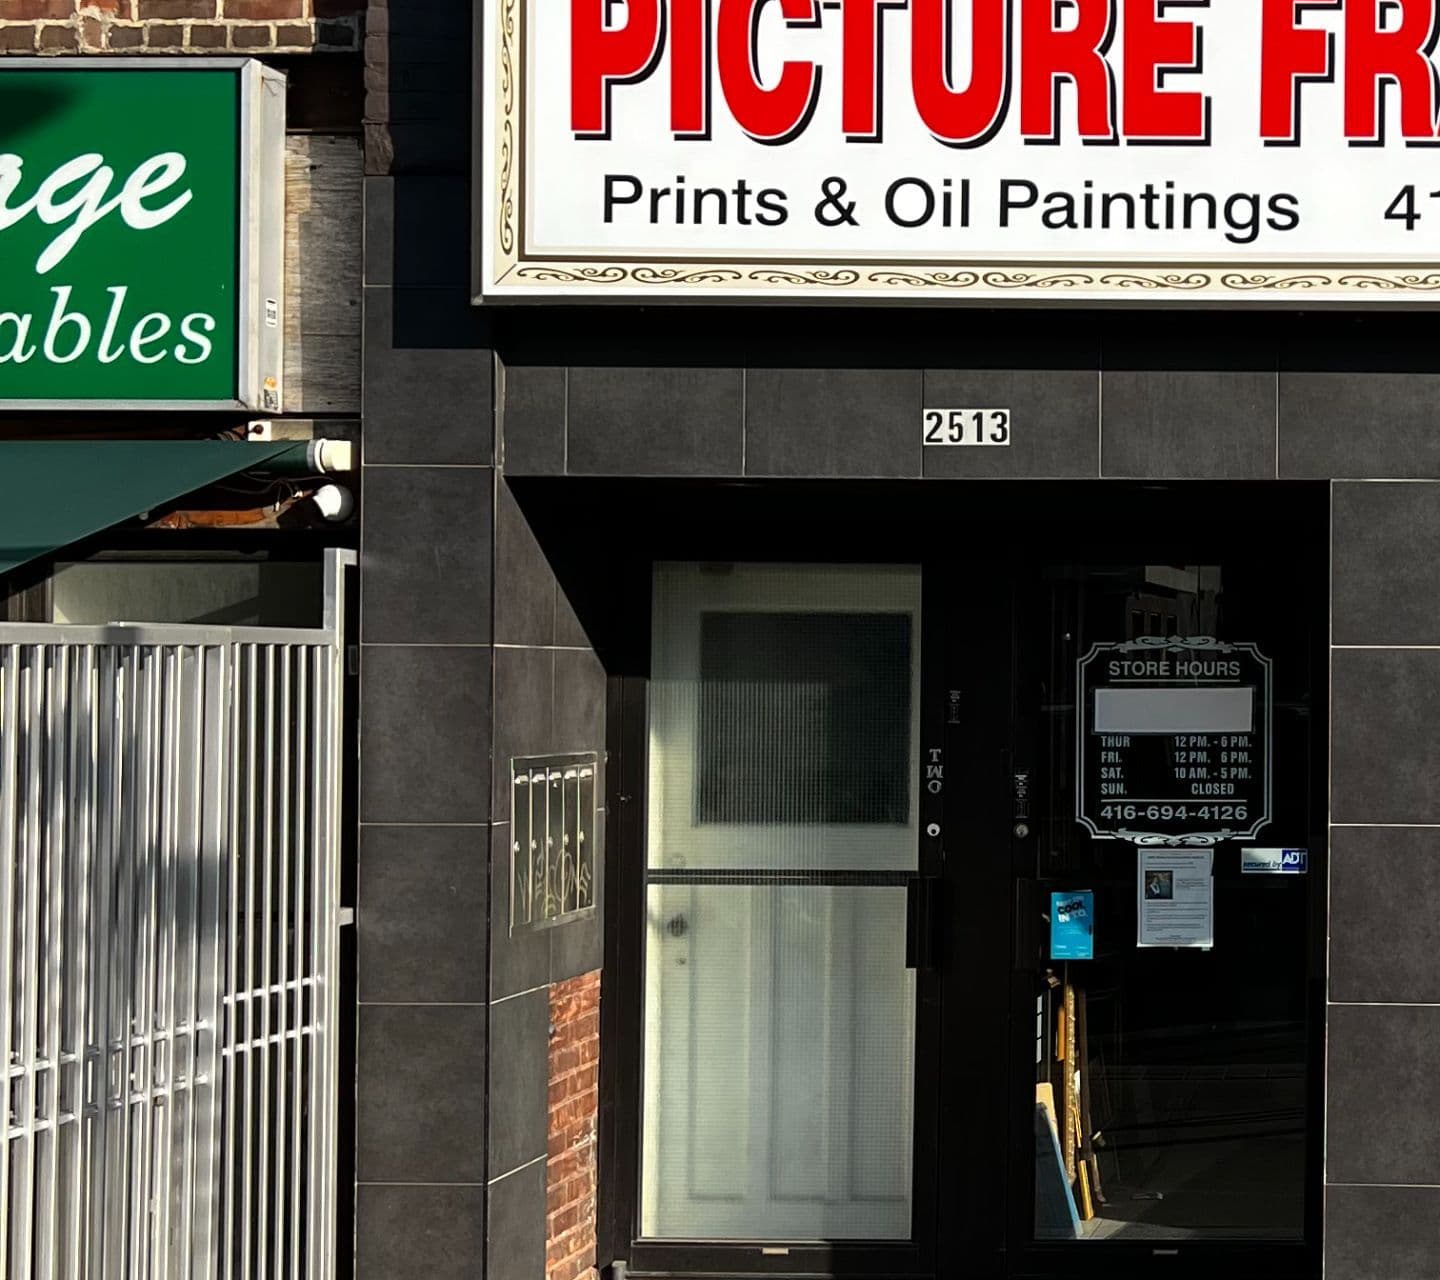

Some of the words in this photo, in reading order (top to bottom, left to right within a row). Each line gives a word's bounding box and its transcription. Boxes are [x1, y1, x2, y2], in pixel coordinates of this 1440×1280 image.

[603, 175, 789, 227] Prints
[813, 177, 860, 228] &
[884, 177, 971, 228] Oil
[999, 178, 1300, 245] Paintings
[924, 410, 1009, 443] 2513
[1108, 661, 1171, 676] STORE
[1175, 661, 1241, 676] HOURS
[1100, 735, 1131, 748] THUR
[1174, 735, 1187, 748] 12
[1100, 751, 1123, 764] FRI.
[1174, 751, 1187, 764] 12
[1100, 767, 1125, 779] SAT.
[1174, 767, 1187, 779] 10
[1100, 783, 1128, 795] SUN.
[1190, 783, 1235, 795] CLOSED
[1100, 805, 1248, 820] 416-694-4126
[1283, 851, 1306, 865] ADT
